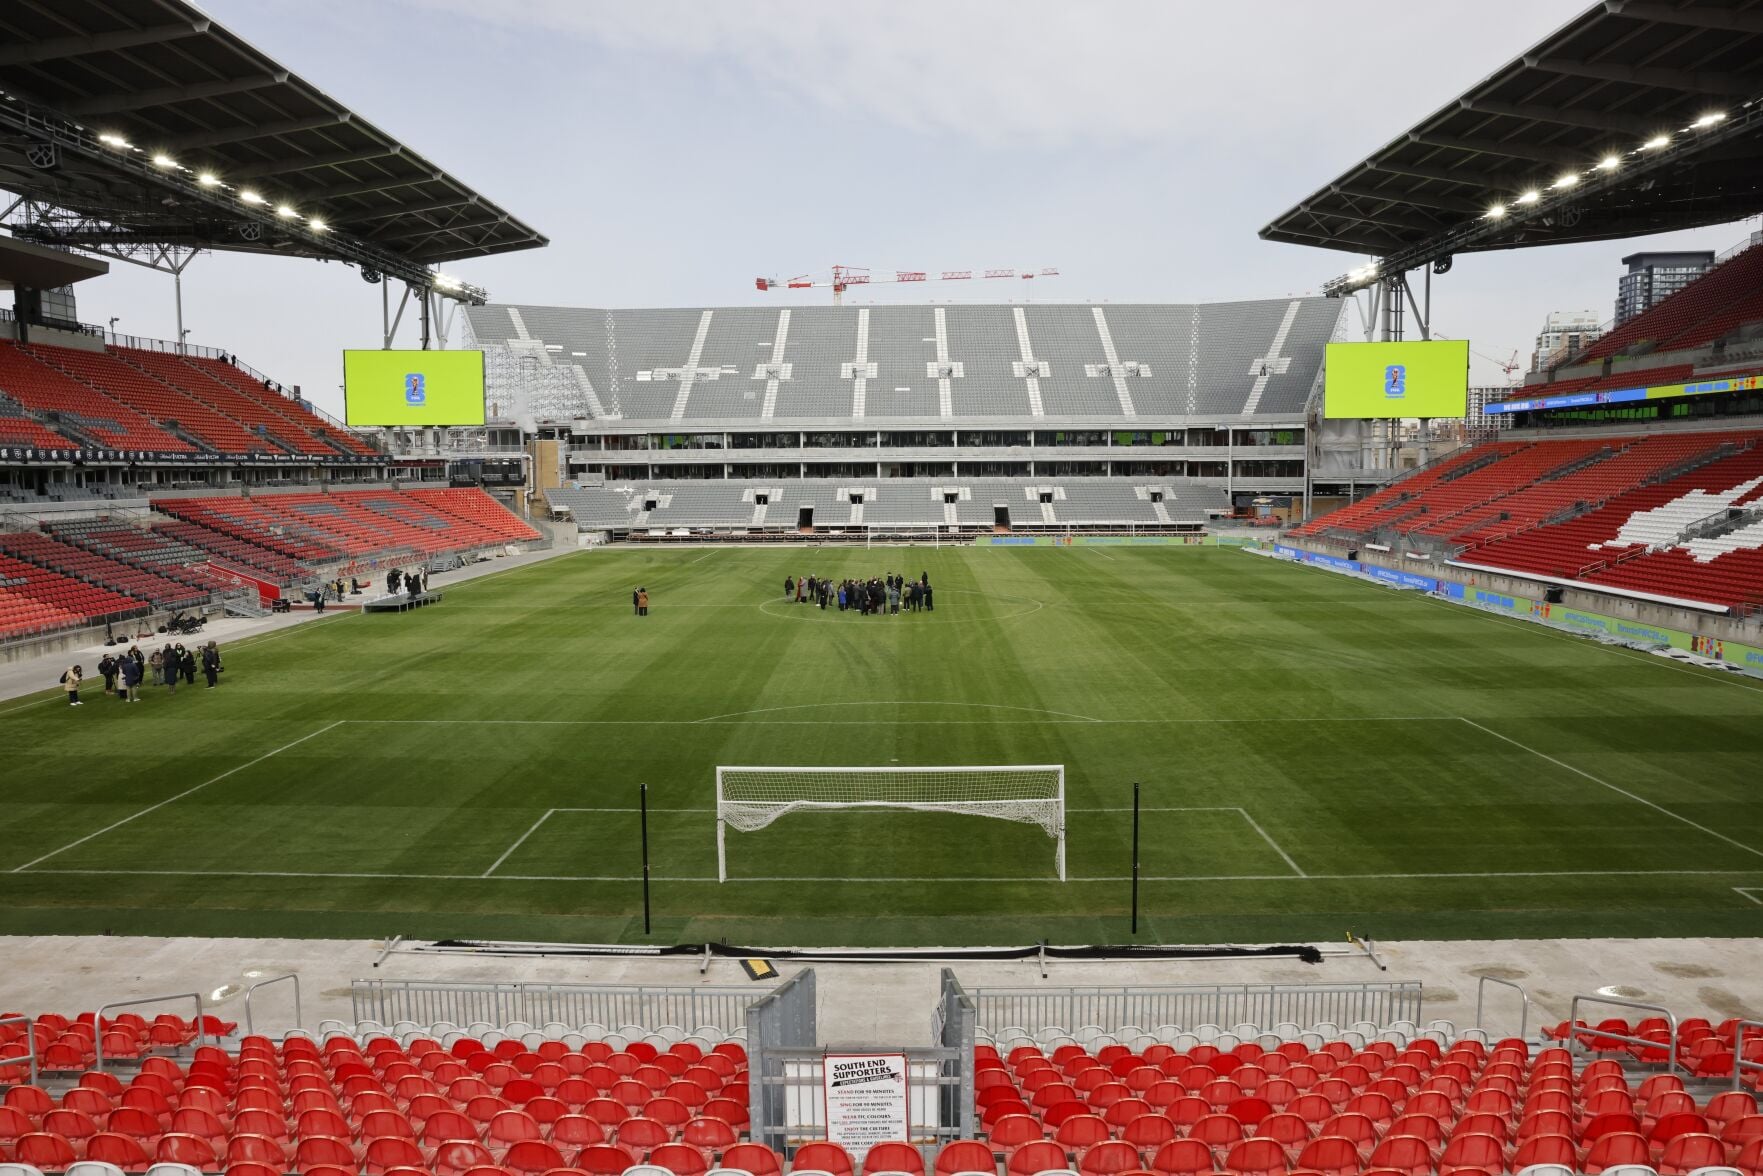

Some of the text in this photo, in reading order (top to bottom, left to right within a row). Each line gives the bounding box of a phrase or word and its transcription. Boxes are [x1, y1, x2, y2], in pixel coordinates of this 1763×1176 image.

[834, 1059, 886, 1071] SOUTH END
[834, 1066, 891, 1079] SUPPORTERS
